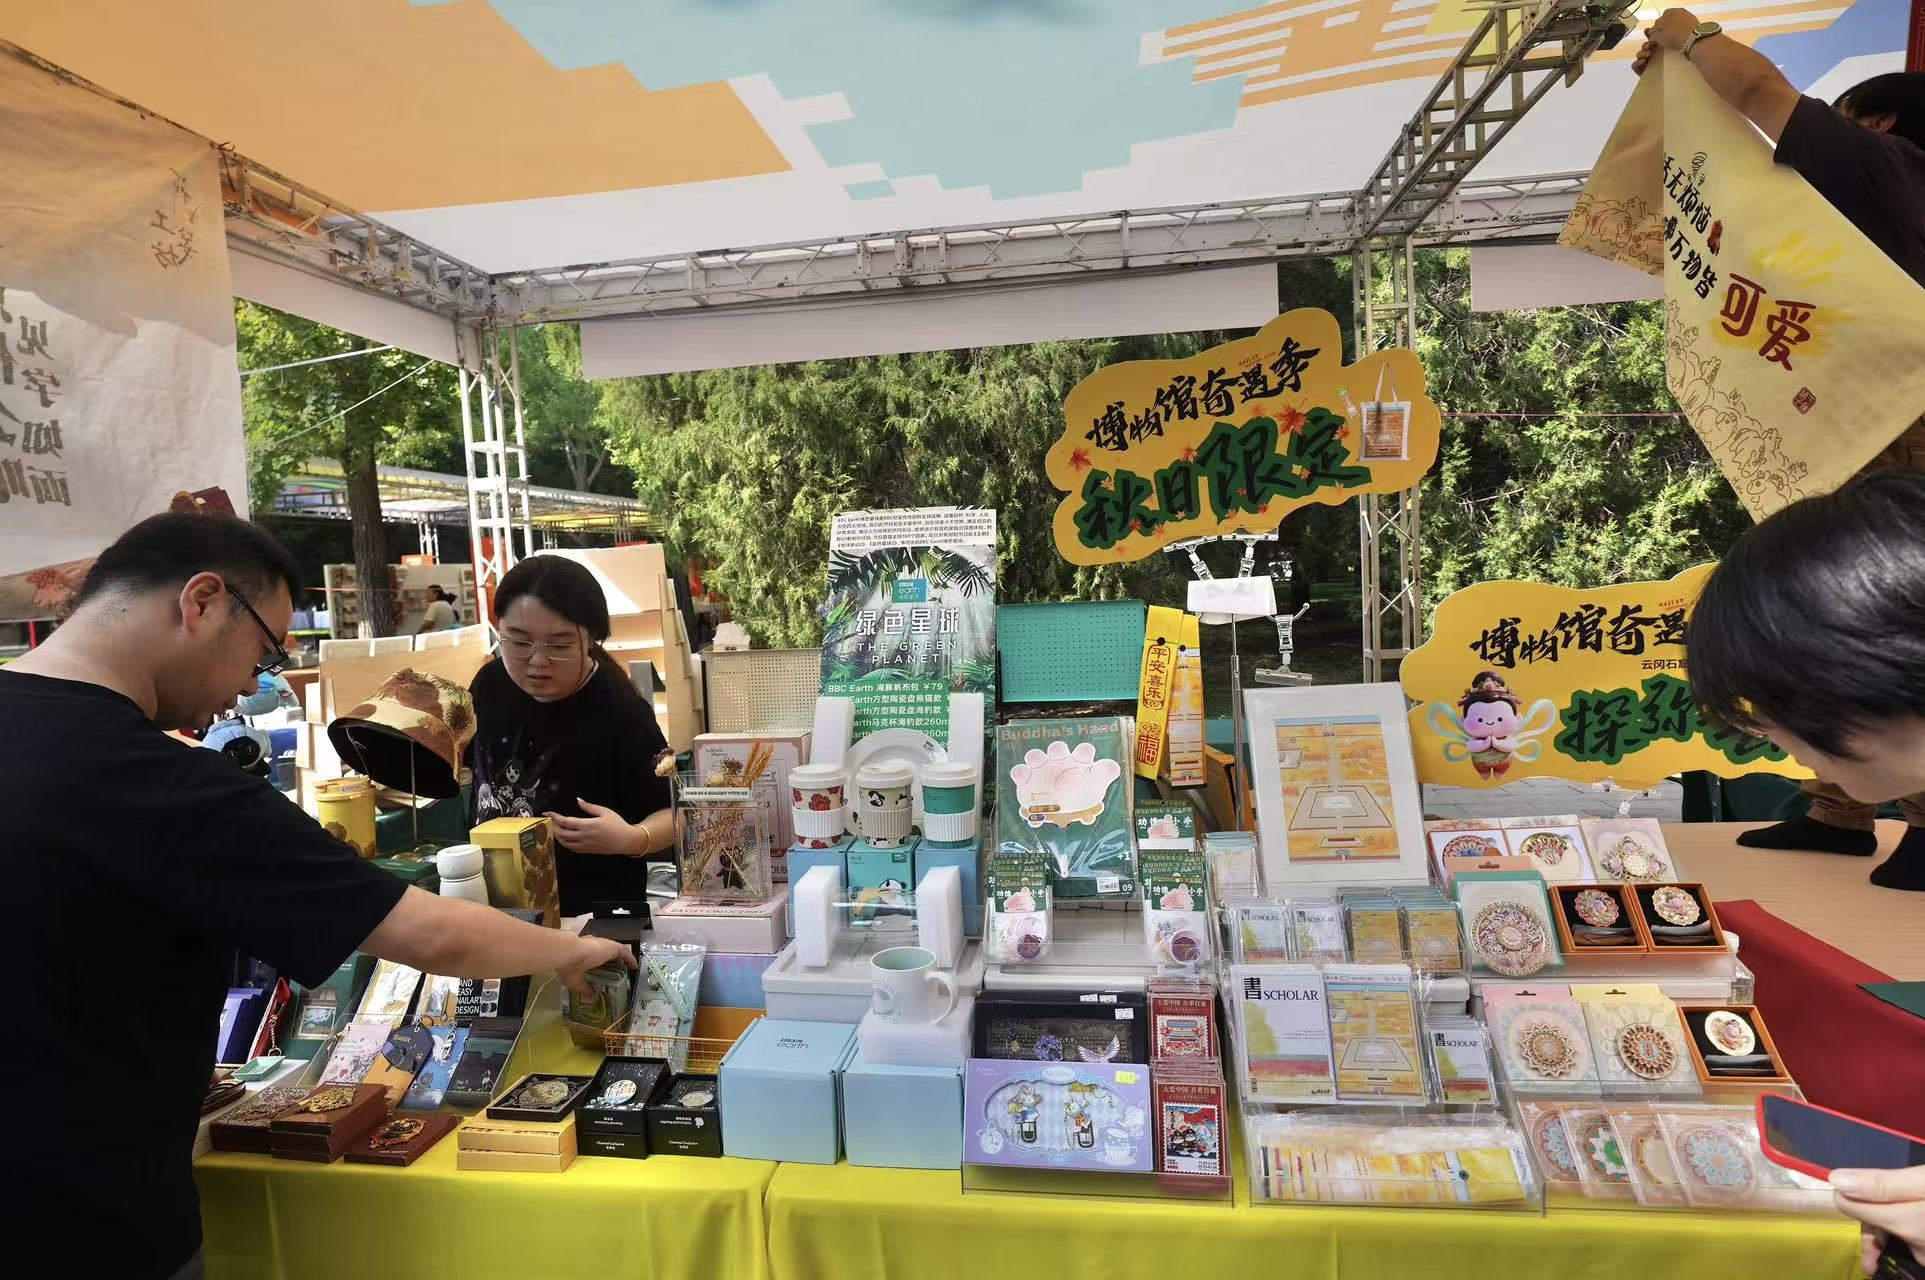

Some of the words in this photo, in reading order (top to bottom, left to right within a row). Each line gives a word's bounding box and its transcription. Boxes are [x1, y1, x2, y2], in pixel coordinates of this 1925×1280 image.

[1720, 273, 1816, 371] 可爱
[1085, 337, 1322, 452] 博物馆奇遇季
[1084, 422, 1365, 536] 秋日限定
[855, 608, 960, 636] 绿色星球
[1469, 603, 1689, 669] 博物馆奇遇
[857, 642, 888, 651] THE
[899, 640, 958, 651] GREEN
[871, 653, 941, 664] PLANET
[1147, 648, 1167, 699] 平安喜乐
[828, 685, 847, 693] BBC
[849, 684, 874, 692] Earth
[1001, 727, 1073, 741] Buddha's
[1078, 722, 1119, 735] Hand
[1117, 851, 1131, 860] +1
[771, 866, 788, 874] OLID
[1122, 884, 1133, 892] 09
[460, 979, 473, 988] AND
[458, 988, 473, 996] EASY
[1264, 990, 1319, 1000] SCHOLAR
[455, 1006, 480, 1014] DESIGN
[1163, 1085, 1188, 1093] 大爱中国
